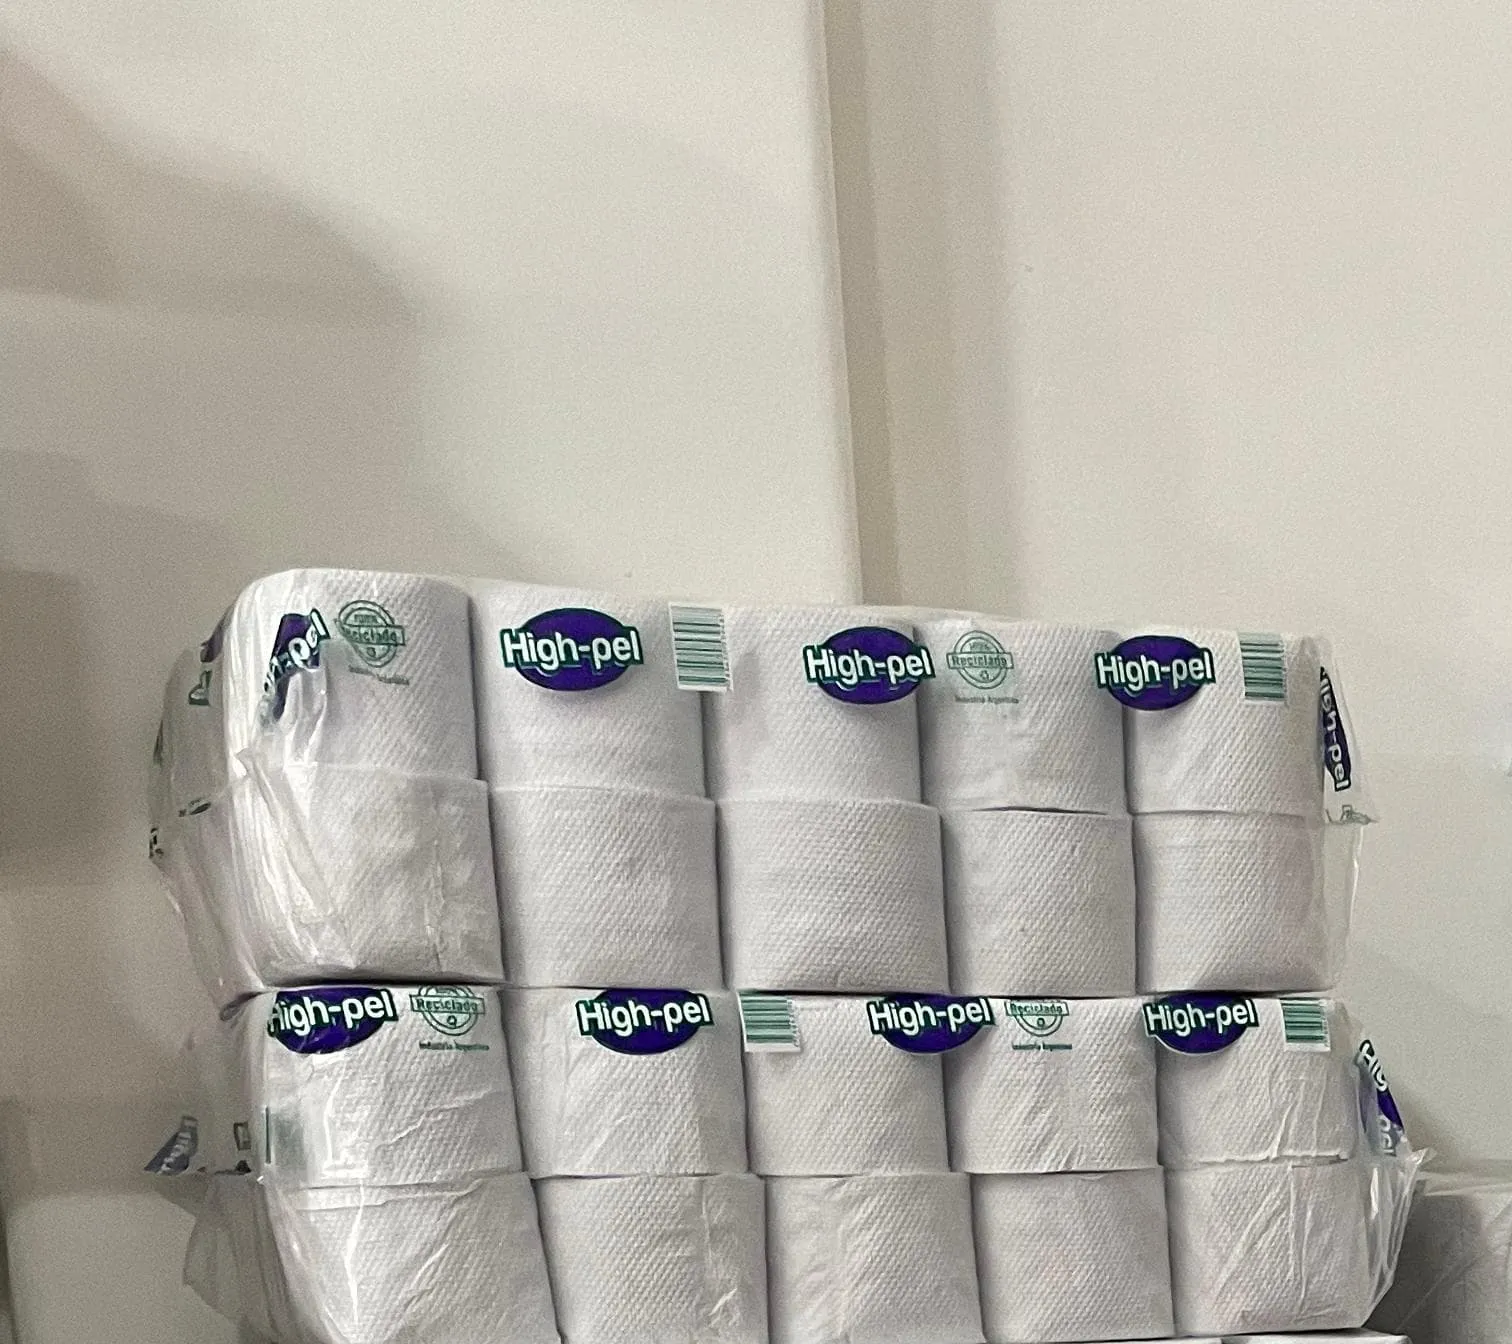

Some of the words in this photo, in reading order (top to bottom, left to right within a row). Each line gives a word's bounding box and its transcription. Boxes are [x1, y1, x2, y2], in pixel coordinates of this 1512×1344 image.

[502, 629, 641, 671] High-pel
[806, 647, 932, 685] High-pel
[1097, 650, 1213, 691] High-pel
[270, 989, 394, 1037] High-pel
[578, 996, 711, 1037] High-pel
[868, 997, 991, 1036] High-pel
[1145, 1000, 1256, 1037] High-pel
